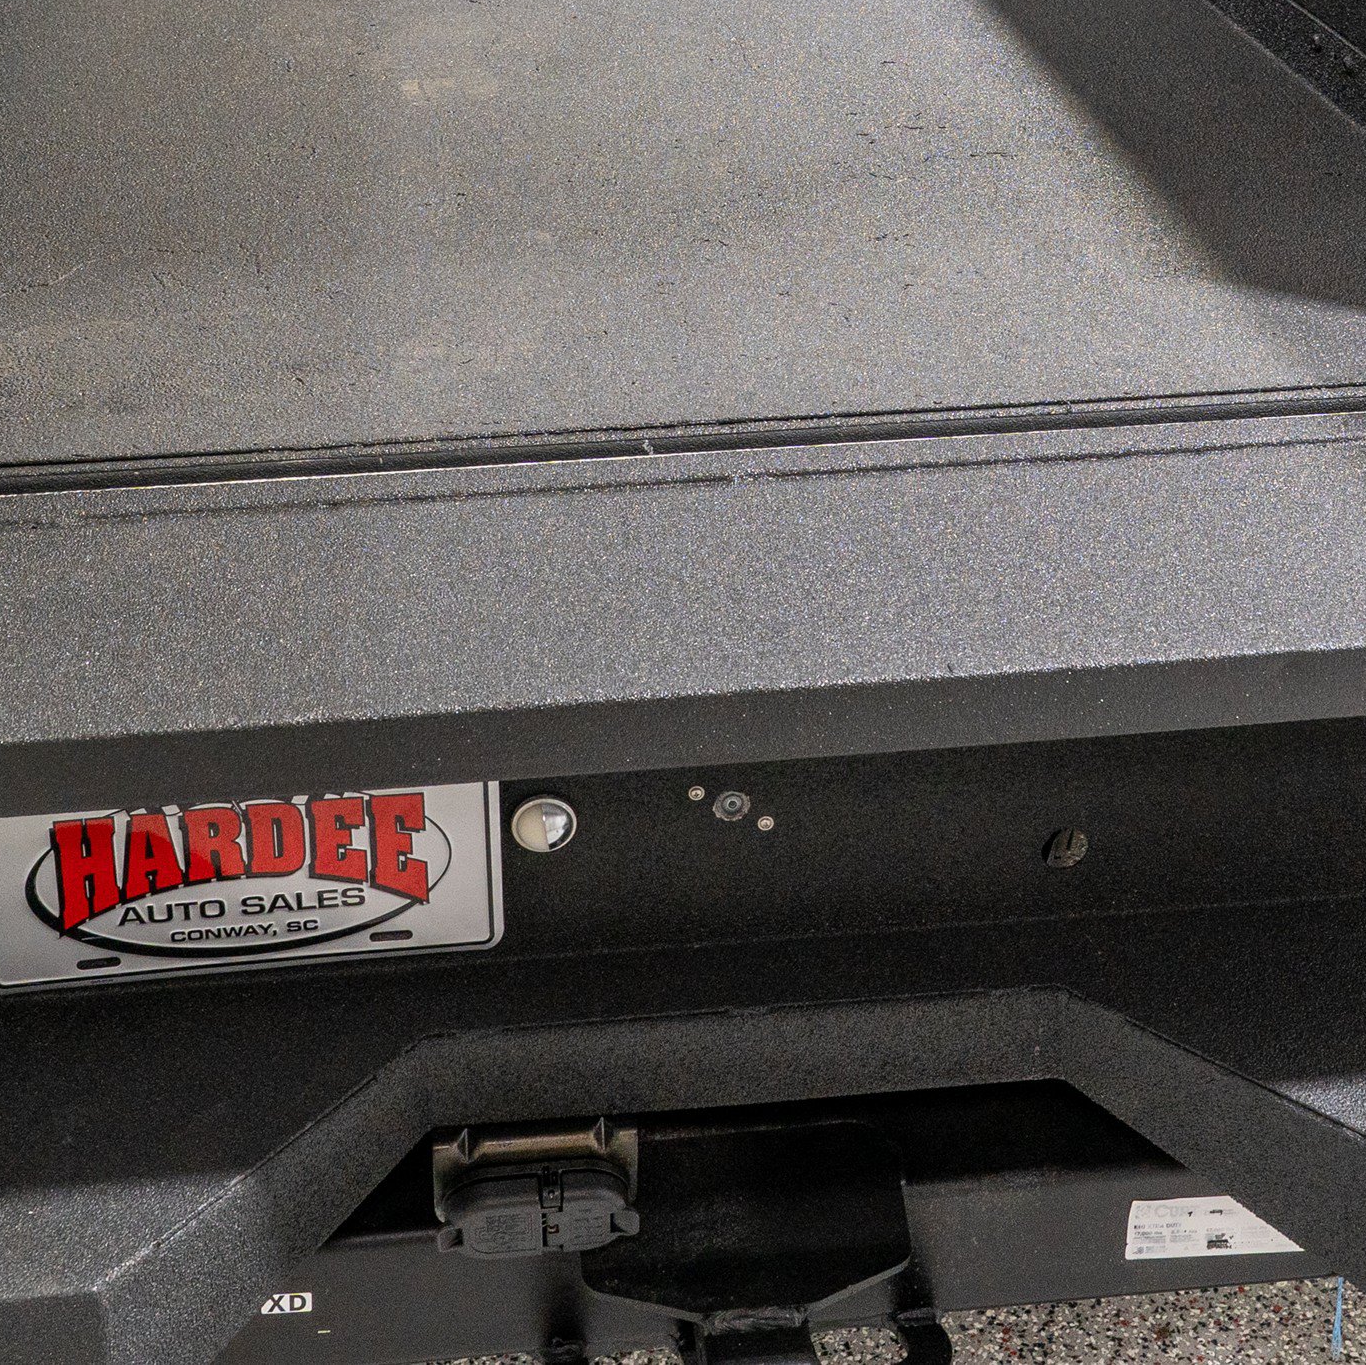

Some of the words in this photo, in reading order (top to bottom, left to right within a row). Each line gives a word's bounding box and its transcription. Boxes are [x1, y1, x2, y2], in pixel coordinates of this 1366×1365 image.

[53, 791, 431, 932] HARDEE
[117, 899, 227, 927] AUTO
[240, 886, 367, 916] SALES
[170, 922, 278, 943] CONWAY,
[286, 918, 320, 934] SC
[267, 1294, 307, 1313] XD
